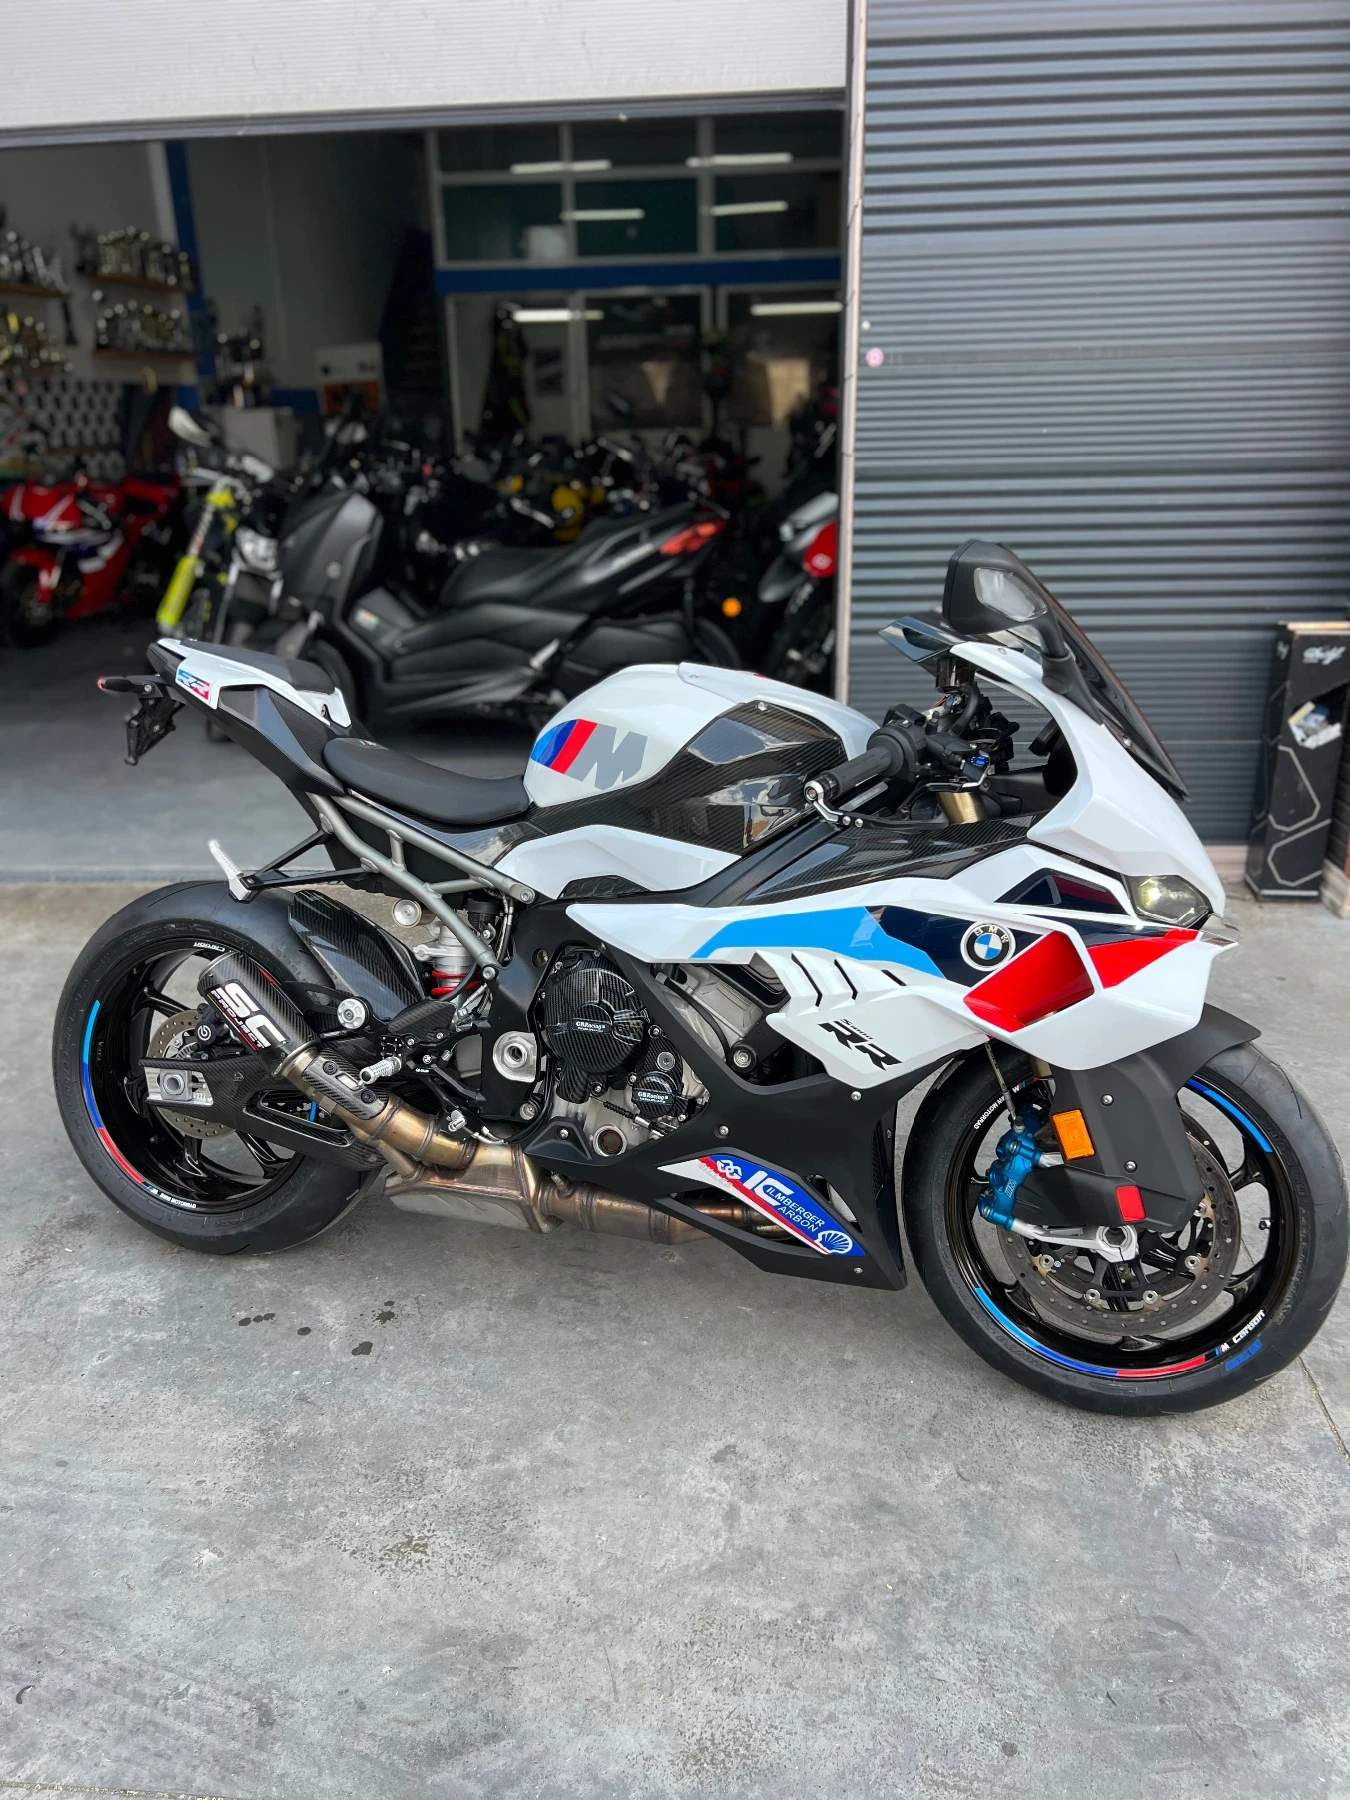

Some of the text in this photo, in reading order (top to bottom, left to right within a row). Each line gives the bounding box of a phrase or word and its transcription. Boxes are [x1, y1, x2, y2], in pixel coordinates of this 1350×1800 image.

[178, 669, 210, 700] RR
[973, 925, 1009, 944] BMW
[210, 989, 265, 1049] PROJECT
[215, 982, 286, 1048] SC
[817, 1020, 903, 1071] RR
[973, 1101, 999, 1130] MOTORRAD
[170, 1197, 197, 1209] MOTORRAD
[766, 1186, 826, 1227] ILMBERGER
[1232, 1309, 1266, 1344] Carbon
